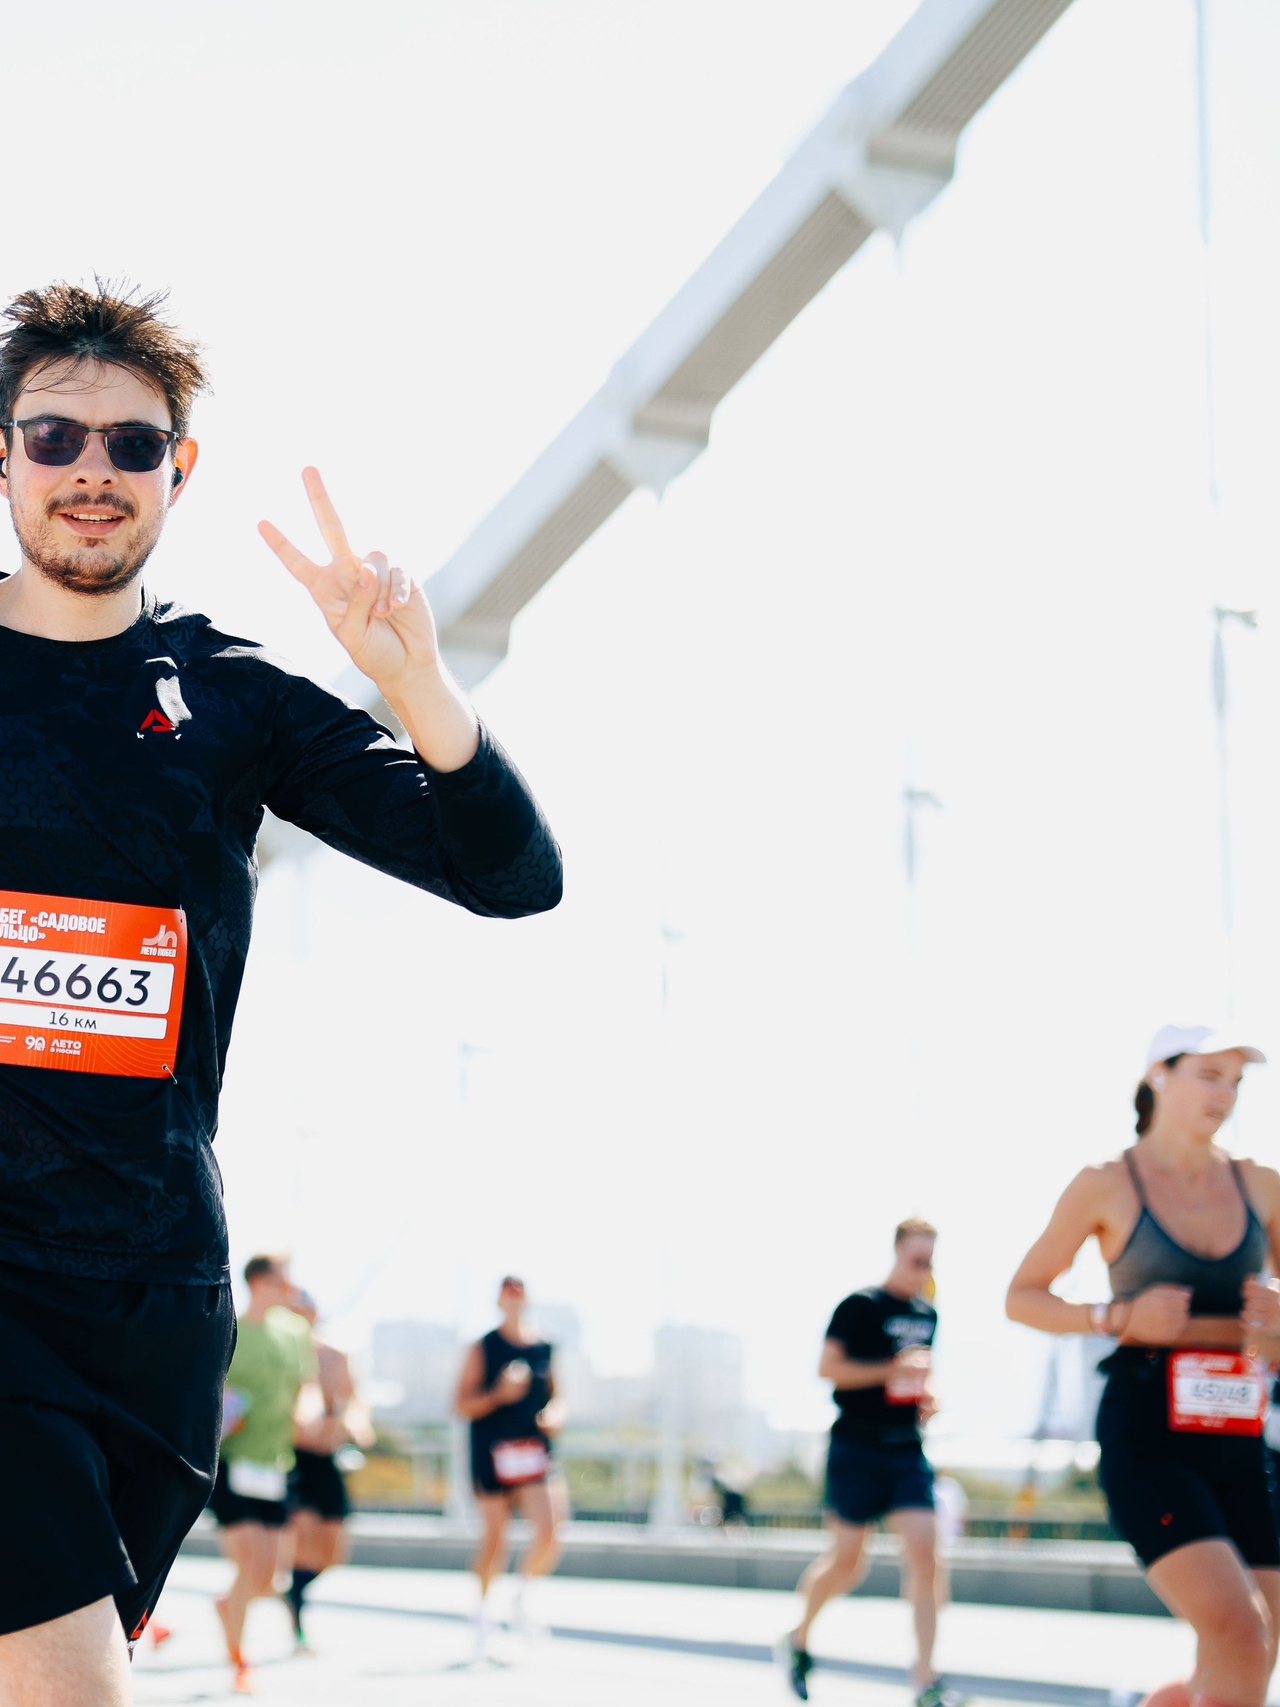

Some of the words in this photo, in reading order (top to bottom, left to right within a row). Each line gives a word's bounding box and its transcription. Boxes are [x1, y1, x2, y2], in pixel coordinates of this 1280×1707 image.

[30, 911, 107, 934] «САДОВОЕ
[0, 956, 151, 1006] 46663
[49, 1011, 69, 1026] 16
[51, 1038, 82, 1050] ЛЕТО
